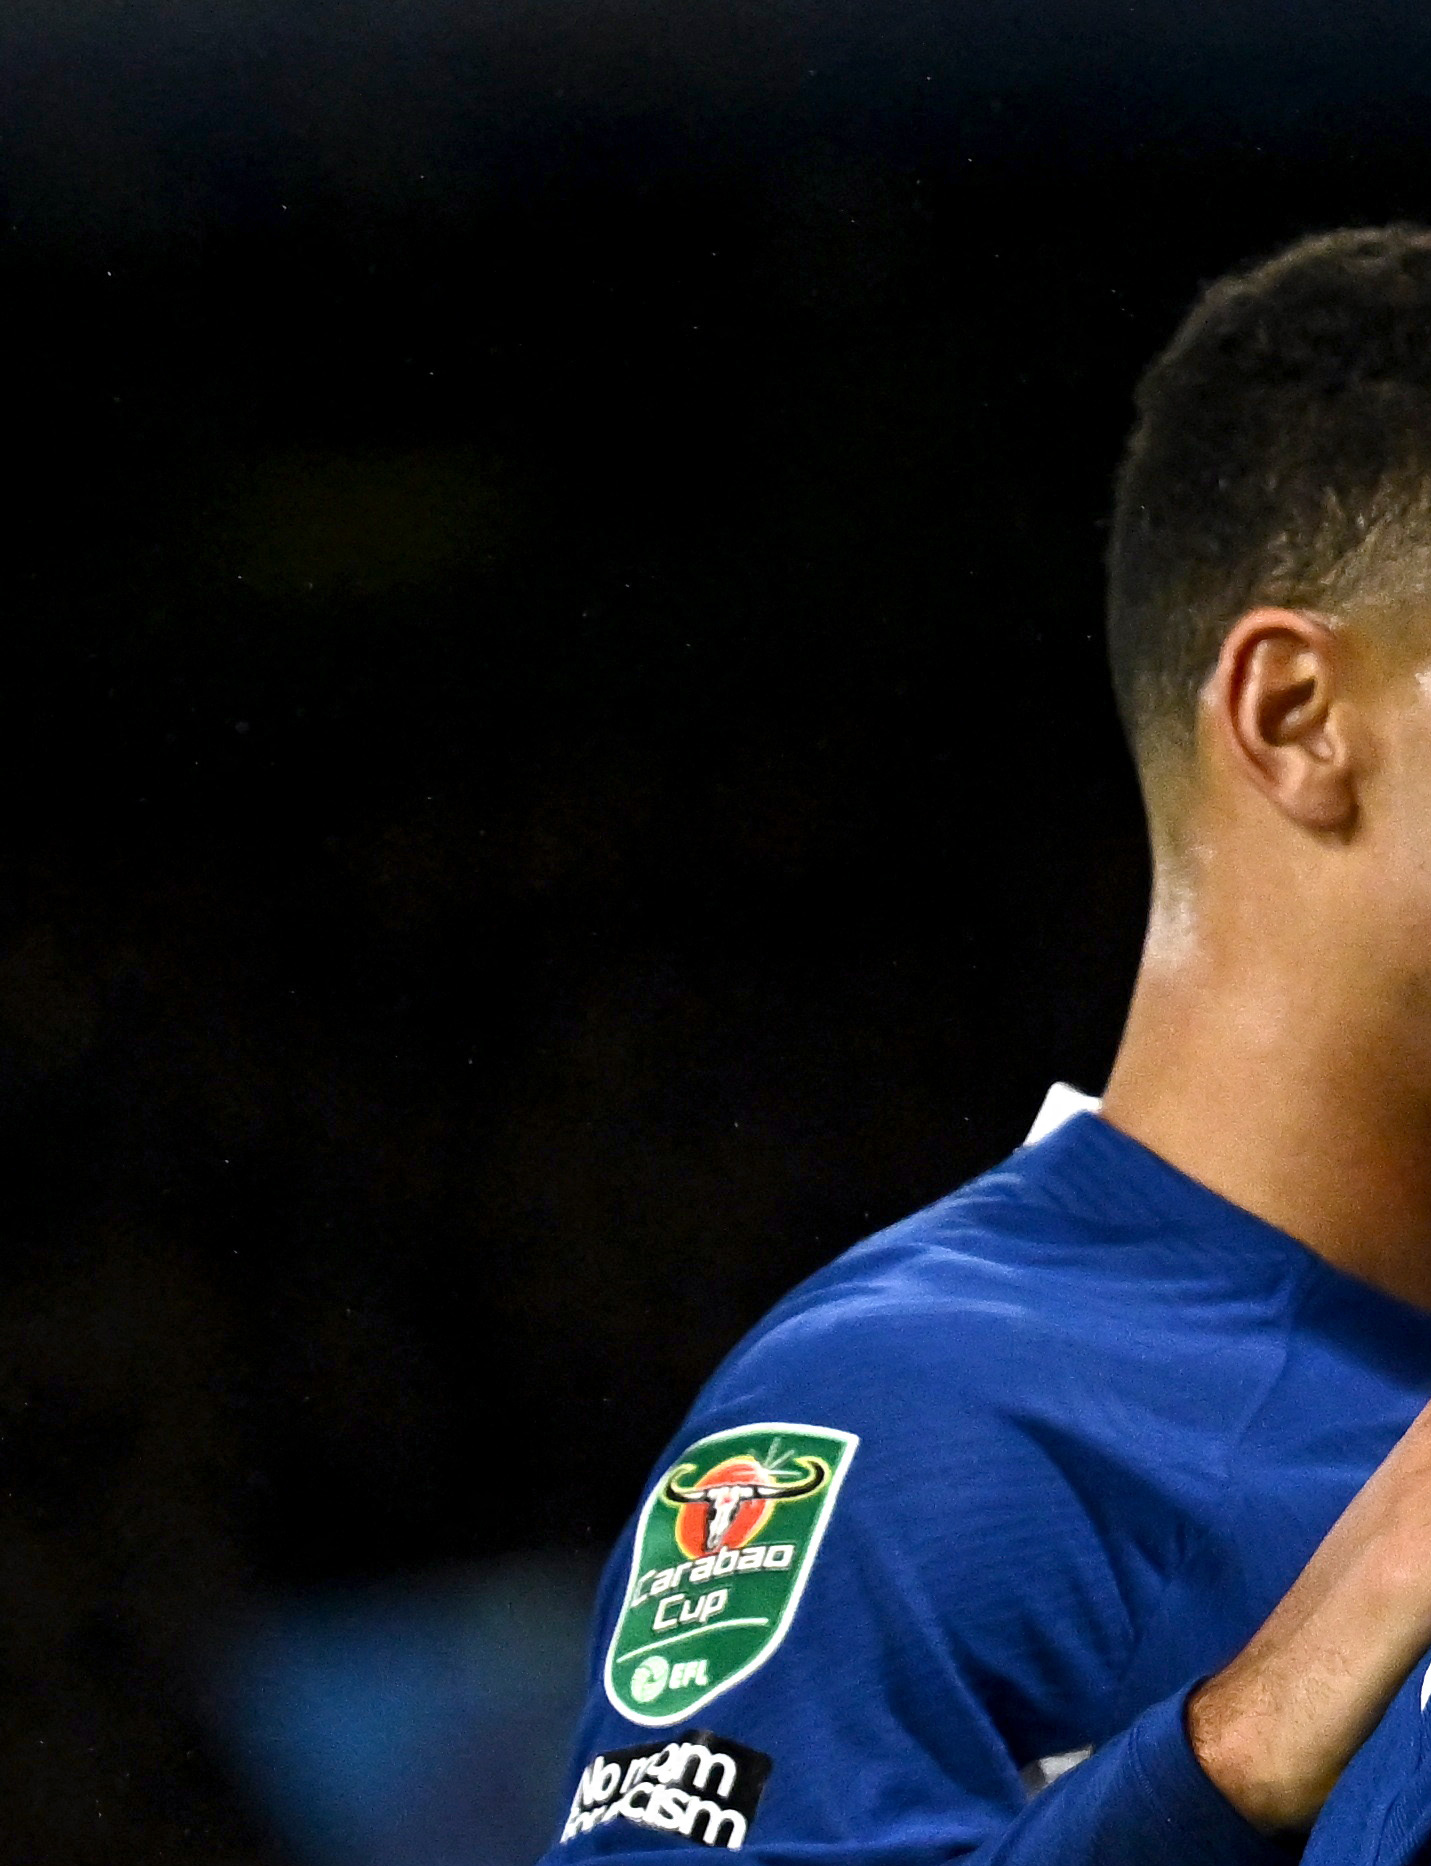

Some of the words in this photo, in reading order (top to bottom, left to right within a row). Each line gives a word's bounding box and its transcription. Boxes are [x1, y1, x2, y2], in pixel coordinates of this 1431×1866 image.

[631, 1543, 796, 1608] Carabao
[652, 1588, 729, 1632] Cup
[668, 1659, 710, 1690] EFL
[572, 1755, 622, 1806] No
